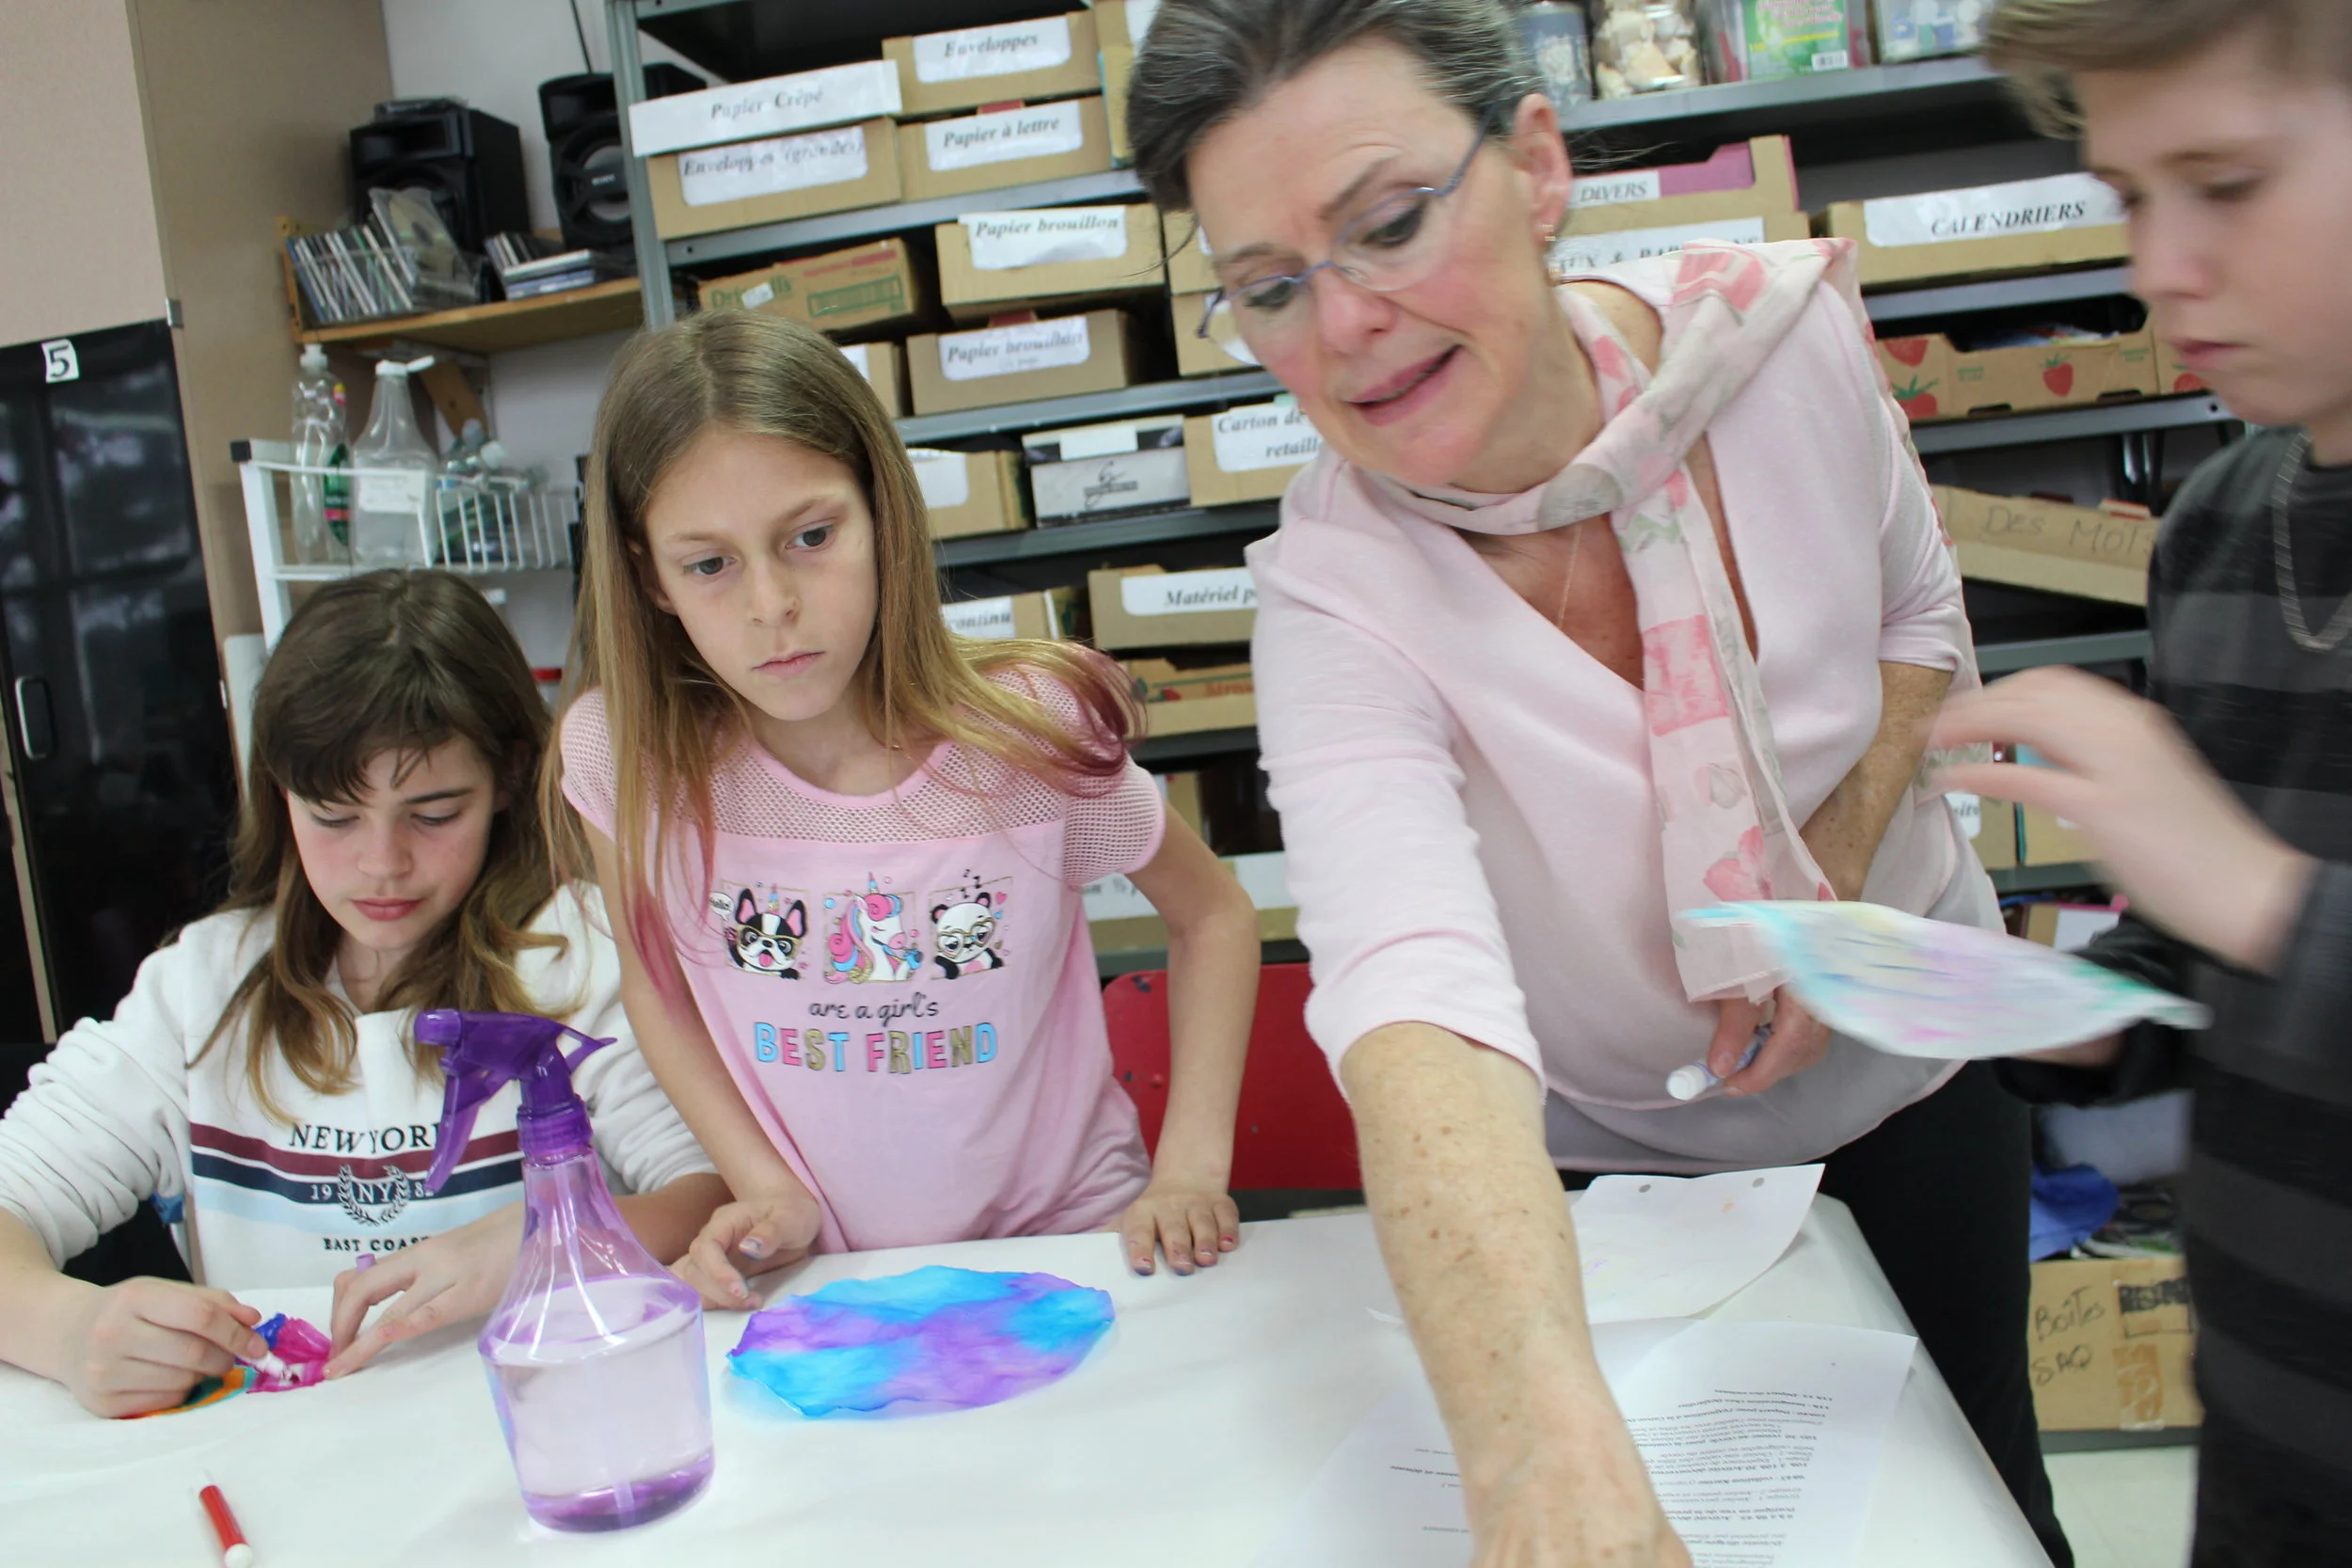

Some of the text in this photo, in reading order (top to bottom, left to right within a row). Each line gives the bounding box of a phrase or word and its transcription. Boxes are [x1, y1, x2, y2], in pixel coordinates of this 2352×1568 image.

[944, 33, 1039, 58] Enveloppes
[710, 97, 764, 119] Papier
[943, 116, 1060, 149] Papier à lettre
[1580, 181, 1648, 202] DIVERS
[975, 214, 1120, 239] Papier brouillon
[1931, 199, 2086, 236] CALENDRIERS
[47, 344, 71, 377] 5
[946, 340, 1000, 365] Papier
[1216, 412, 1279, 434] Carton
[1264, 436, 1319, 458] retaill
[1165, 584, 1239, 607] Matériel
[808, 991, 939, 1027] are a girl's
[754, 1022, 997, 1074] BEST FRIEND
[289, 1123, 364, 1153] NEW
[310, 1183, 332, 1200] 19
[358, 1181, 392, 1204] NY
[414, 1182, 434, 1197] 8
[323, 1237, 360, 1251] EAST
